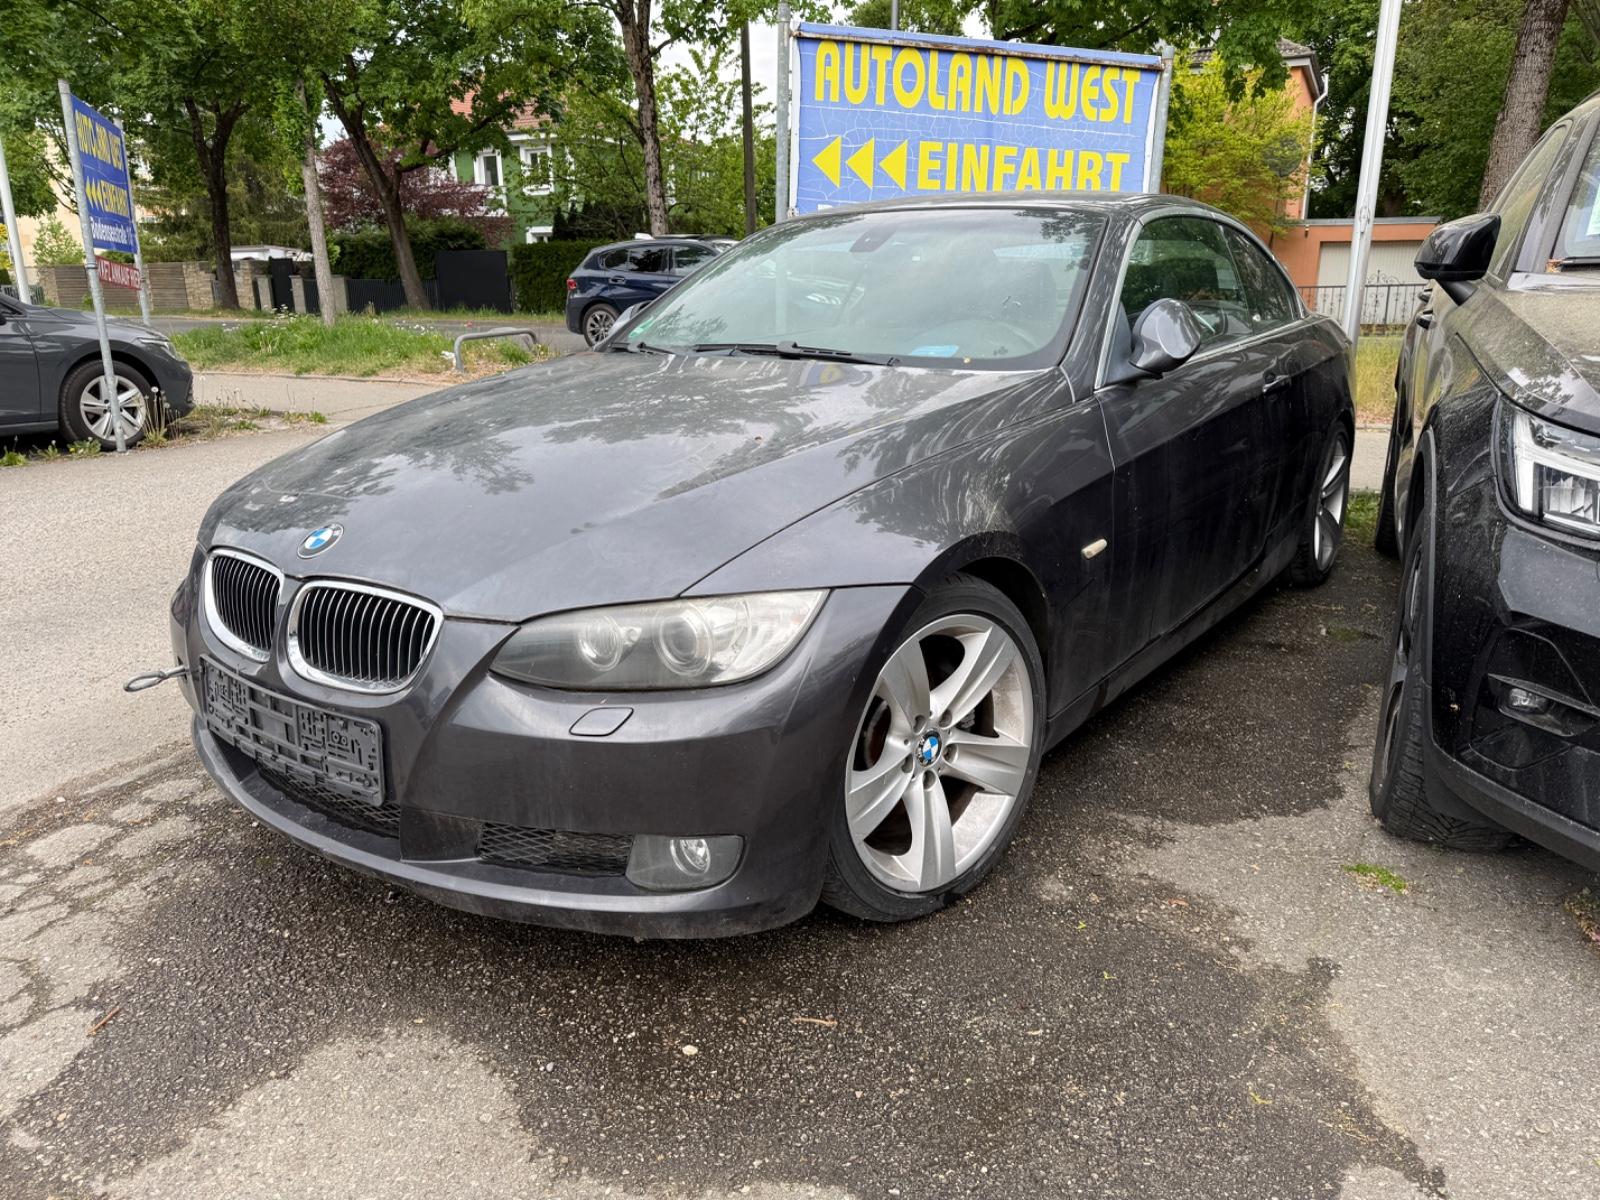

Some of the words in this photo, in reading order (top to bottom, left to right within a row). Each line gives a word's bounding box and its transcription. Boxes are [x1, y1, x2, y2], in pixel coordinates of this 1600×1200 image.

[814, 40, 1030, 117] AUTOLAND
[1043, 60, 1141, 124] WEST
[916, 140, 1131, 193] EINFAHRT
